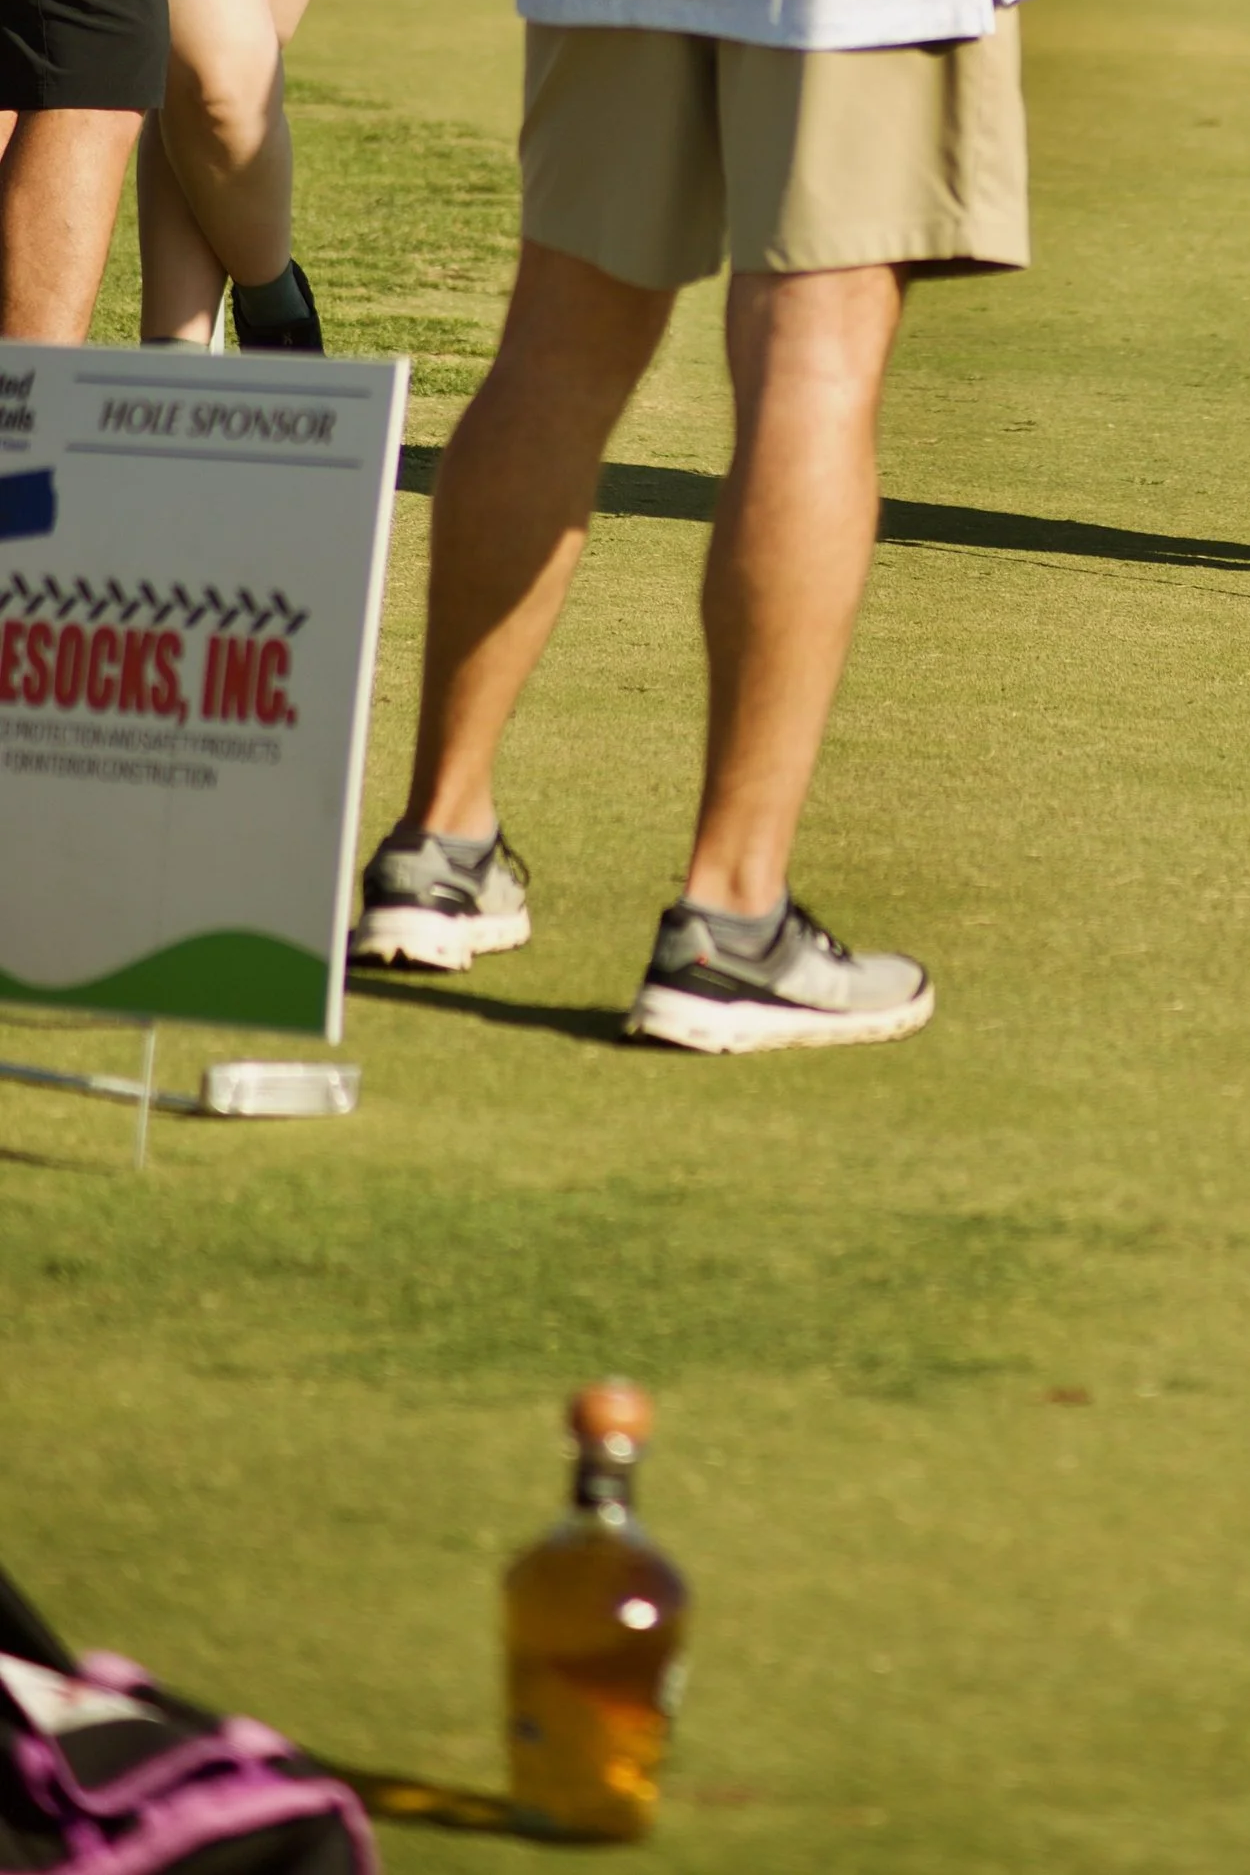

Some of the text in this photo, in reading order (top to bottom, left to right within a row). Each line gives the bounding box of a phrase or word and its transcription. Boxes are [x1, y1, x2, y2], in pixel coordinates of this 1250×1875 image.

[98, 397, 337, 446] HOLE SPONSOR
[200, 635, 298, 729] INC.
